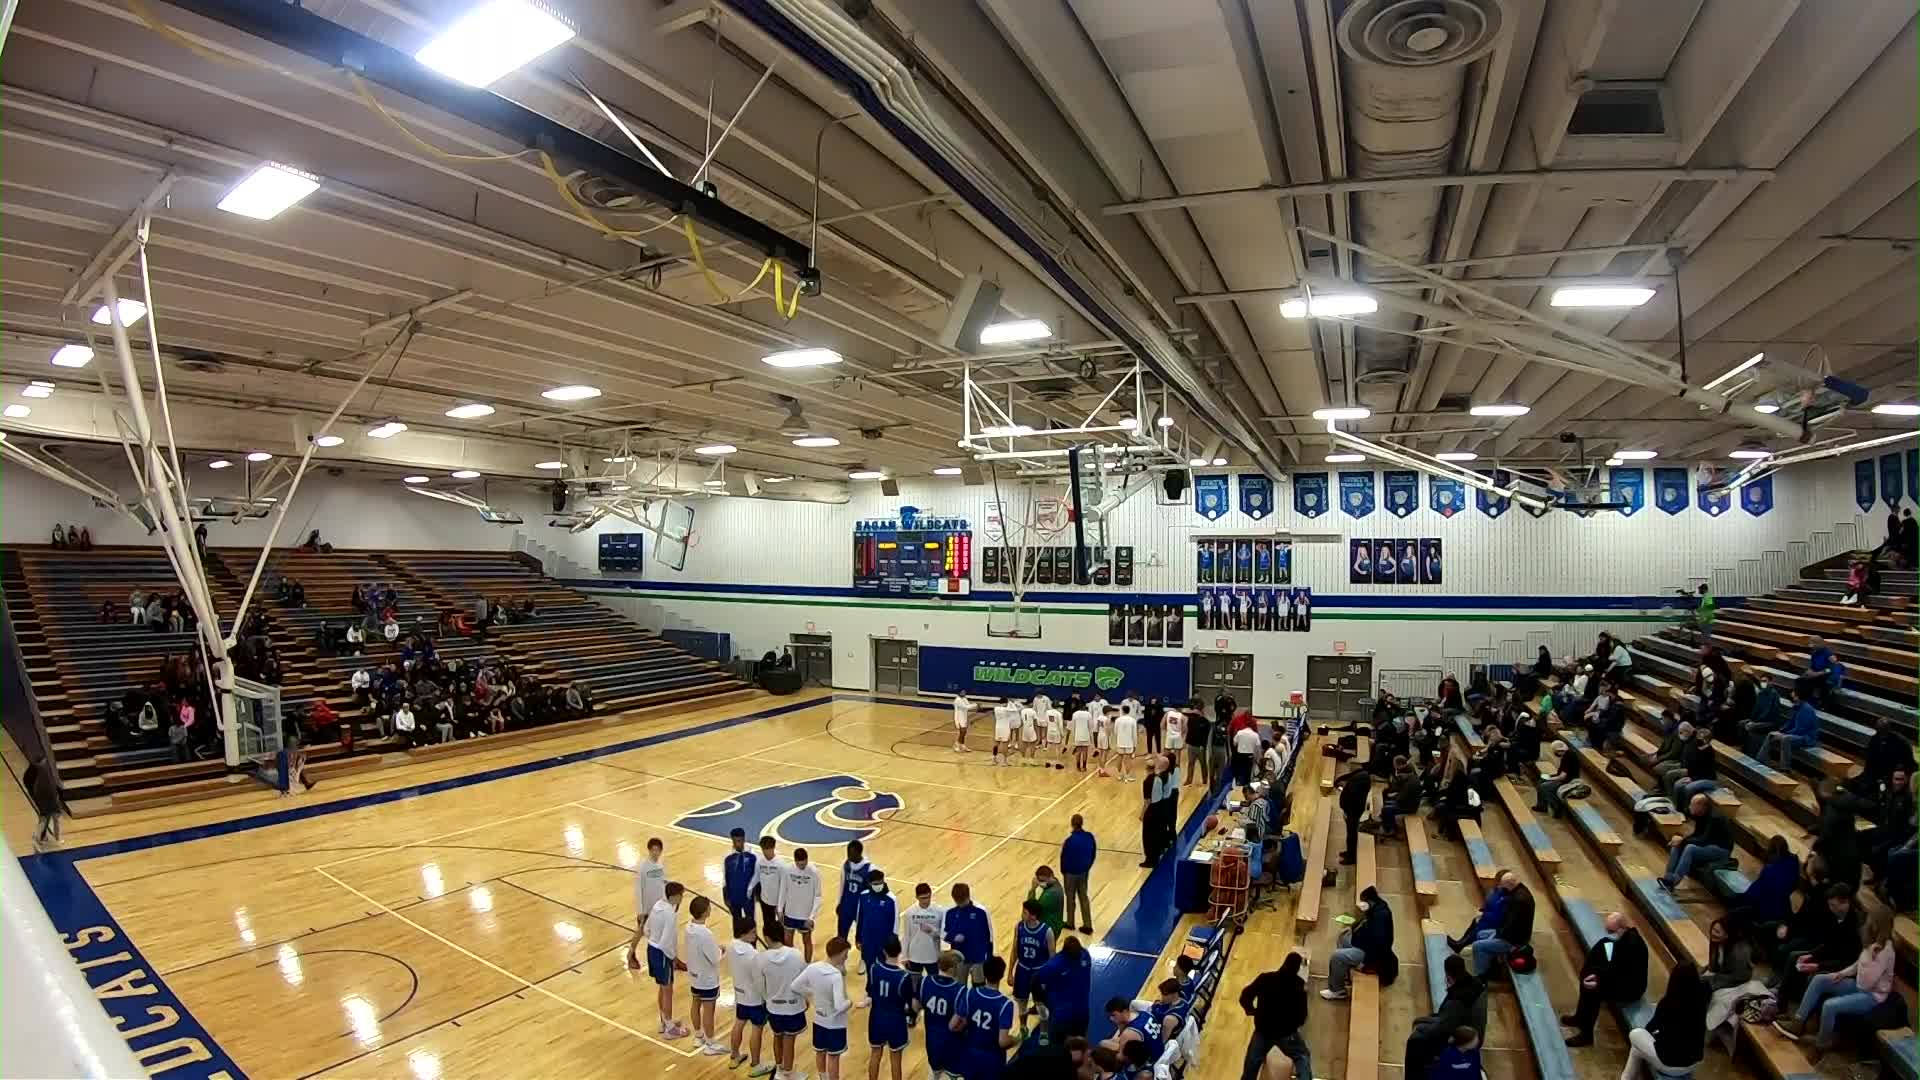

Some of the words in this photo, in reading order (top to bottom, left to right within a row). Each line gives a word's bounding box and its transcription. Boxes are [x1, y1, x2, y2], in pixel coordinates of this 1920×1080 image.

[901, 518, 968, 531] WILDCATS
[1231, 660, 1245, 671] 37
[1347, 664, 1362, 675] 38
[974, 666, 1092, 688] WILDCATS
[1023, 946, 1036, 958] 23
[879, 979, 889, 997] 11
[61, 925, 236, 1080] DCATS
[926, 995, 948, 1016] 40
[971, 1008, 993, 1030] 42
